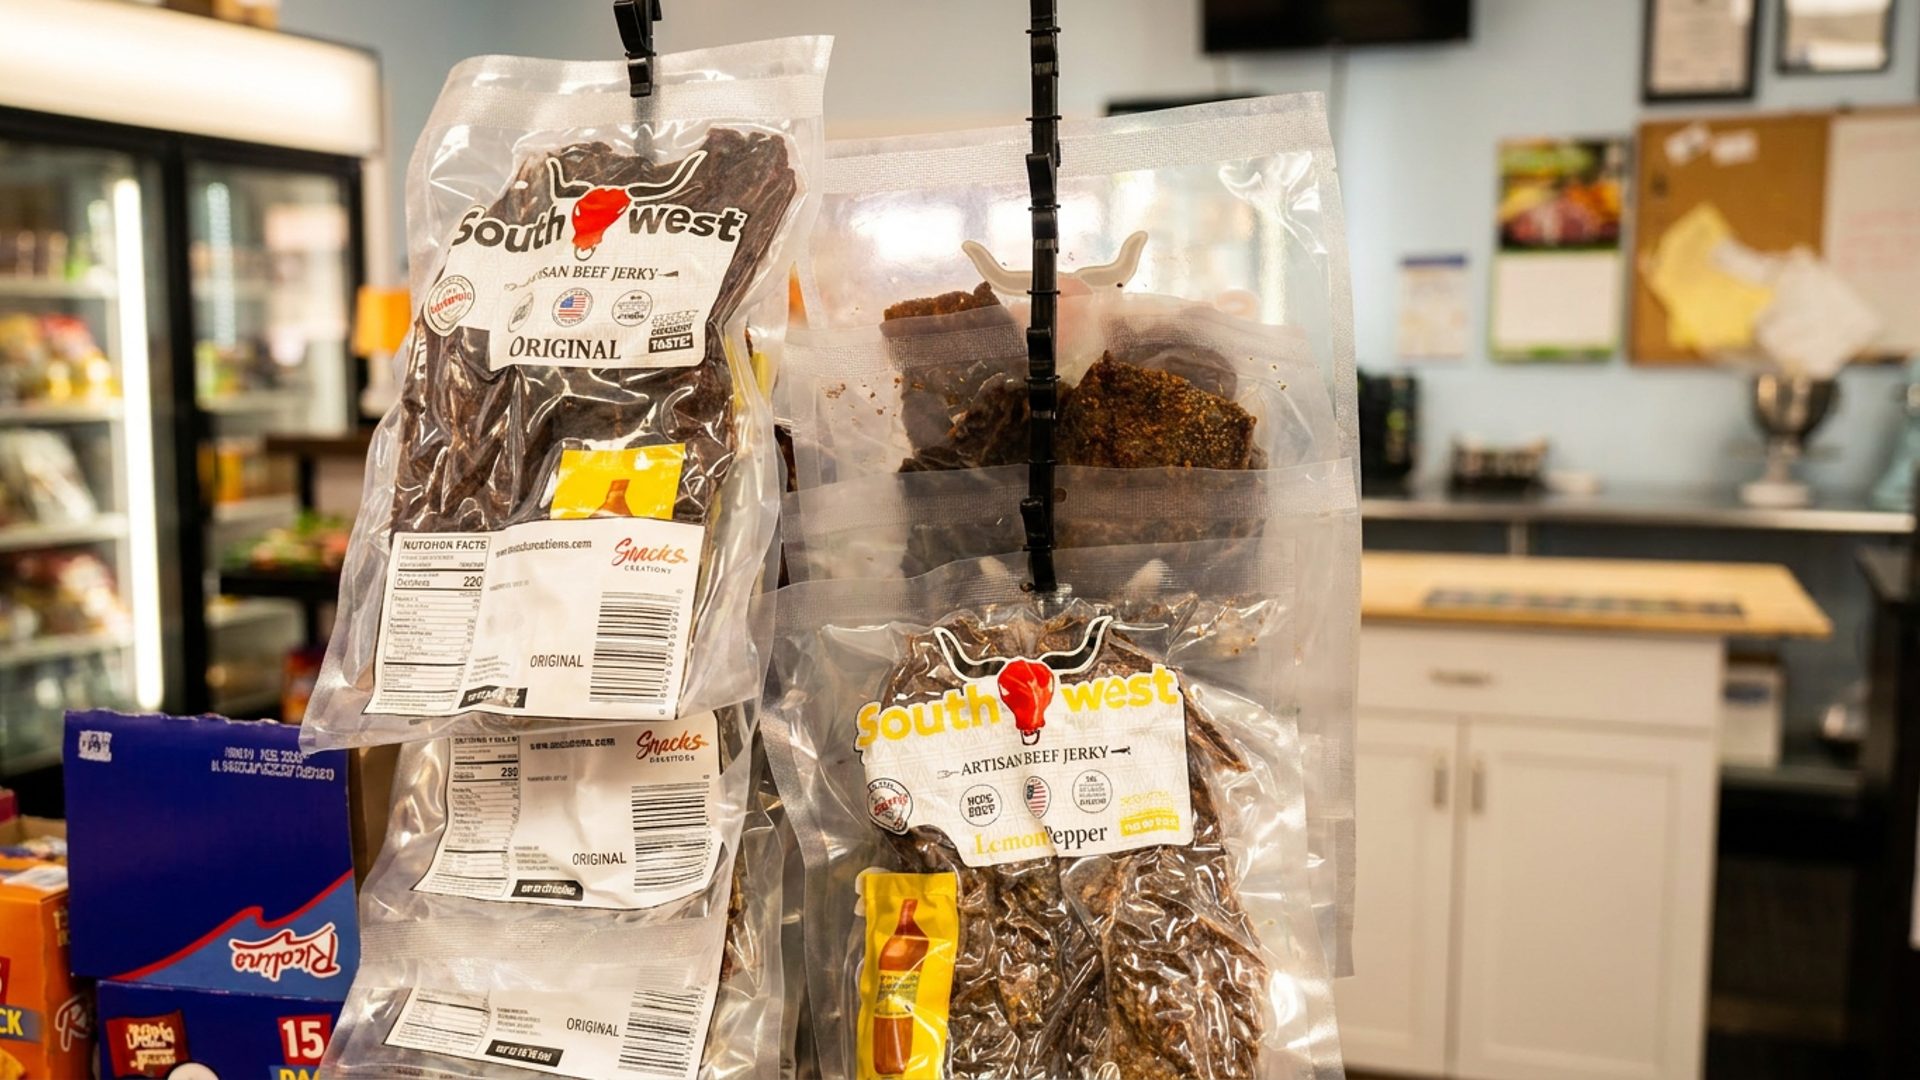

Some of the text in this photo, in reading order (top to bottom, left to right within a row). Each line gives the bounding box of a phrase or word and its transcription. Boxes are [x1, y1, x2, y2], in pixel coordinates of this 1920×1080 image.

[452, 204, 747, 252] South west
[572, 265, 609, 279] BEEF
[610, 266, 658, 281] JERKY
[509, 335, 621, 359] ORIGINAL
[456, 540, 487, 550] FACTS
[463, 575, 483, 588] 220
[530, 654, 584, 668] ORIGINAL
[857, 667, 1179, 747] South west
[961, 745, 1109, 776] ARTISAN BEEF JERKY
[572, 851, 627, 866] ORIGINAL
[231, 927, 339, 981] Ricolino
[566, 1017, 619, 1037] ORIGINAL
[282, 1019, 325, 1059] 15
